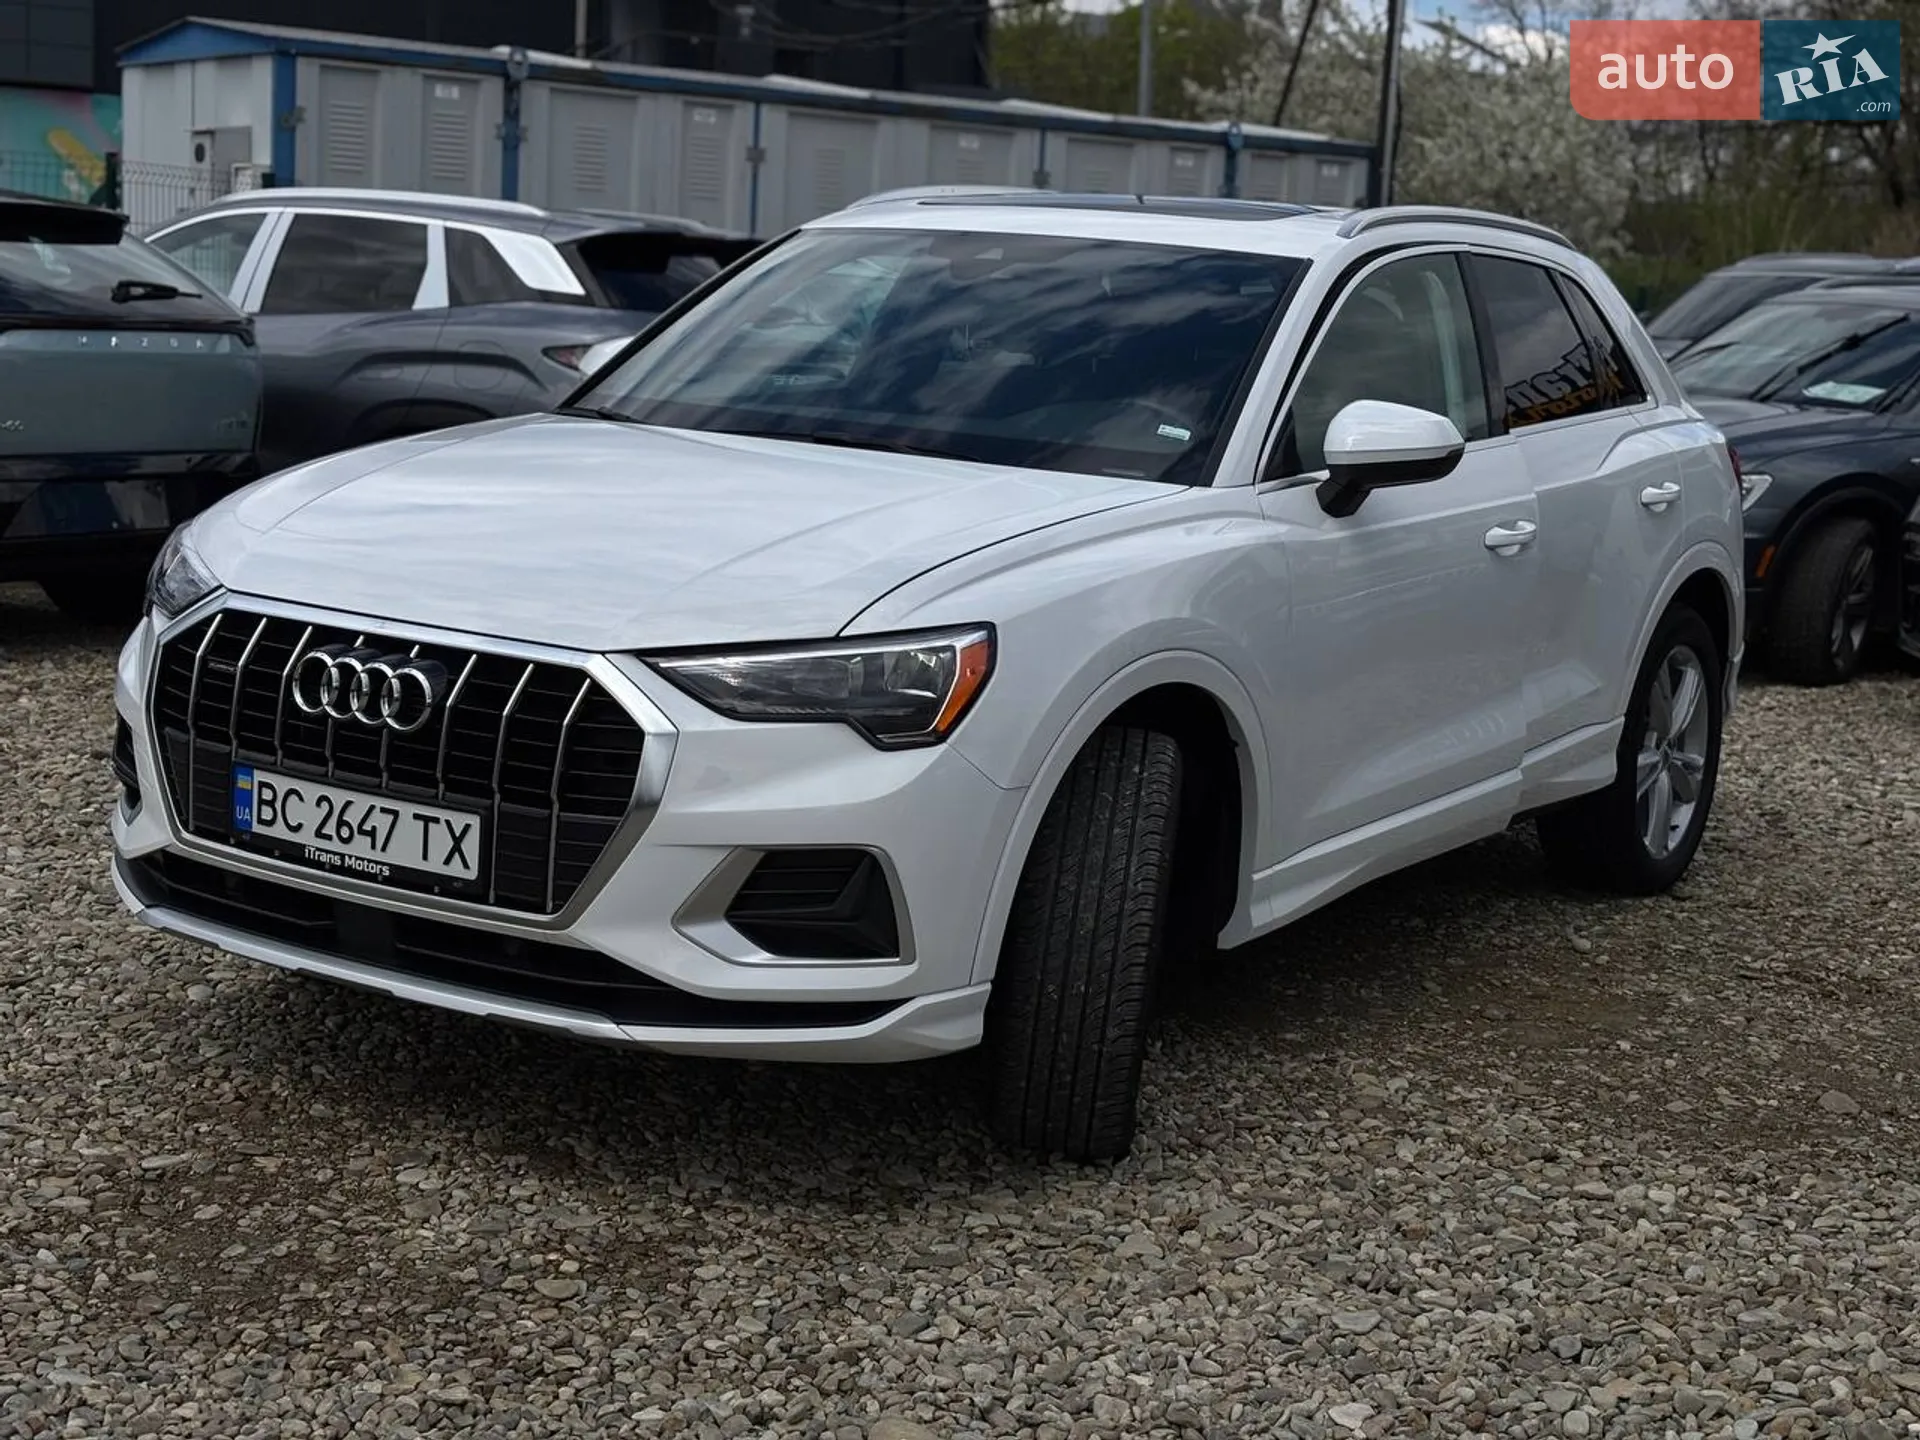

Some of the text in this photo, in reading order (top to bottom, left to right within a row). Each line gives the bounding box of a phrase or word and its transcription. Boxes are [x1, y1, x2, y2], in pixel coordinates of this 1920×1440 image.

[236, 805, 251, 820] UA
[257, 780, 471, 870] BC 2647 TX
[304, 846, 390, 876] iTrans Motors
